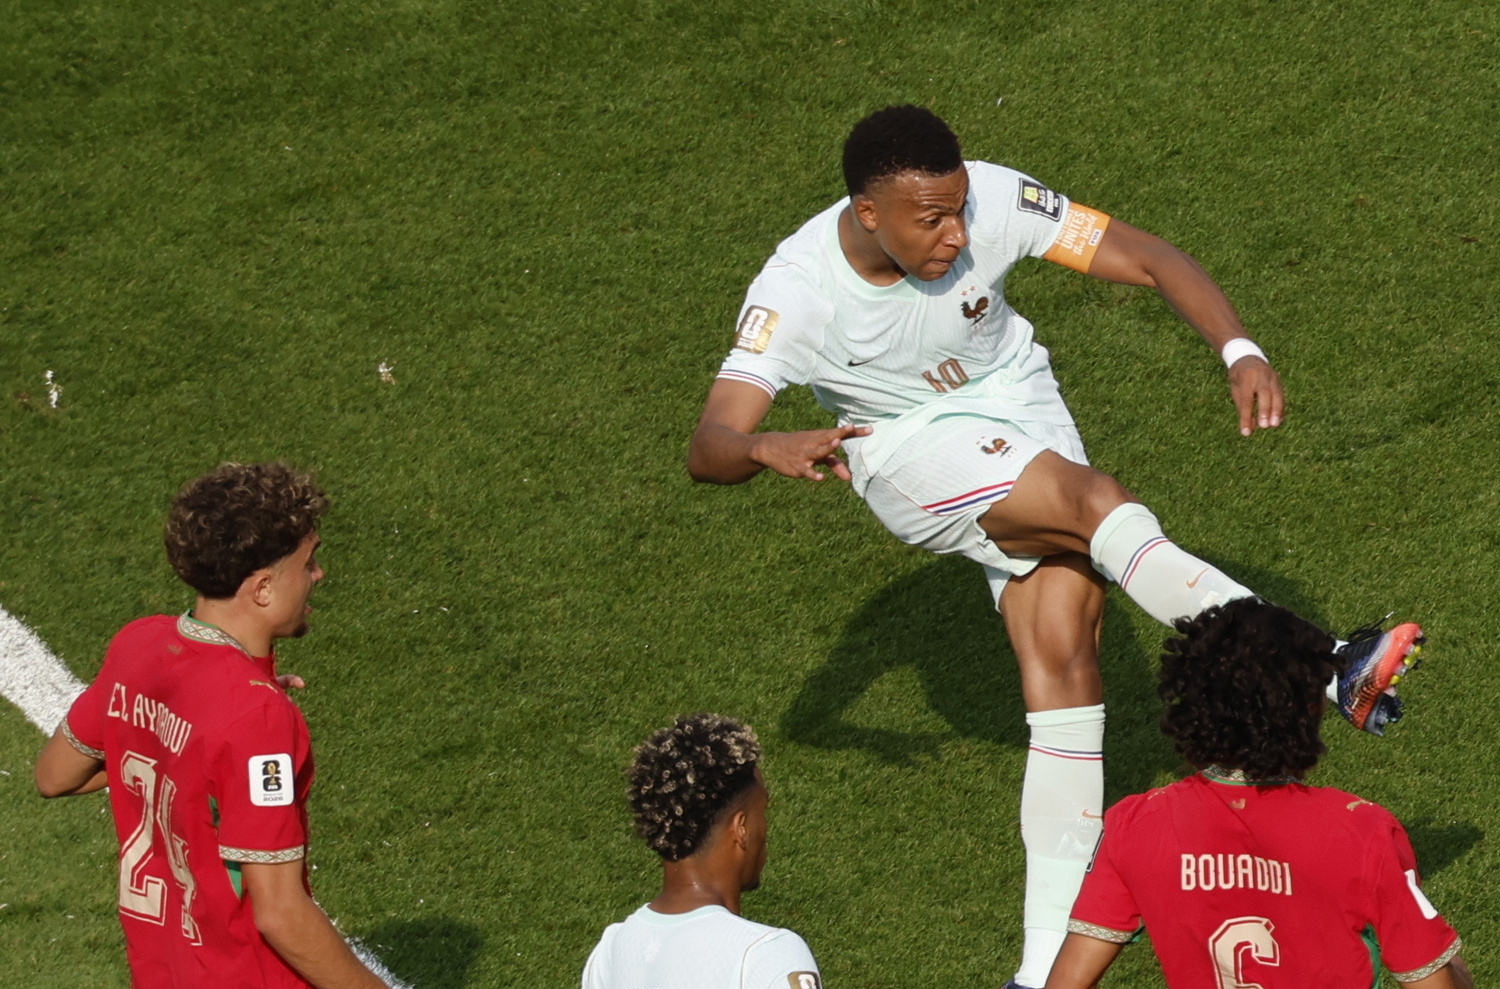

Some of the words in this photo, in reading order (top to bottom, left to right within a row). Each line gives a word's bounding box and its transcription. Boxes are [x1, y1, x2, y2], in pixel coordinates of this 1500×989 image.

[1061, 210, 1087, 249] UNITES
[921, 358, 970, 393] 10
[107, 682, 129, 722] EL
[119, 750, 203, 947] 24
[1180, 853, 1293, 896] BOUADDI
